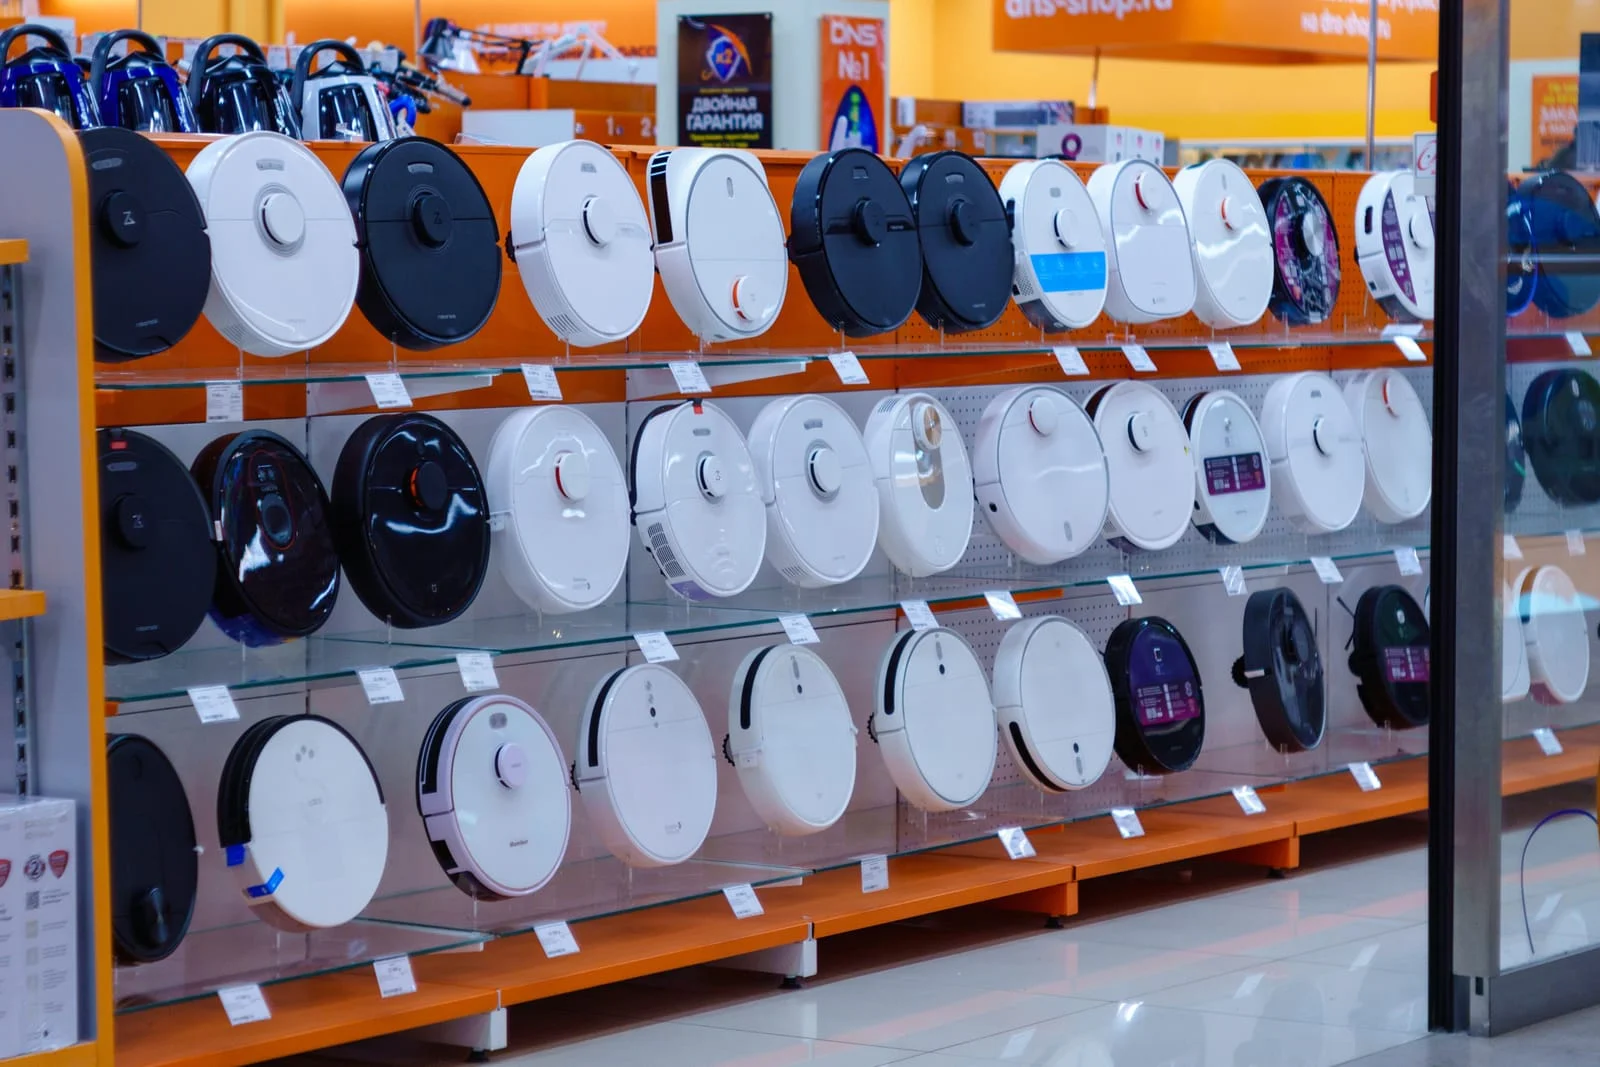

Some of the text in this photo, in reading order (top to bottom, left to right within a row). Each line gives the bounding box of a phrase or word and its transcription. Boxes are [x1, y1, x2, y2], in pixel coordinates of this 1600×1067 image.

[830, 20, 877, 47] DNS
[838, 51, 869, 80] №1
[692, 94, 757, 113] ДВОЙНАЯ
[686, 112, 764, 131] ГАРАНТИЯ
